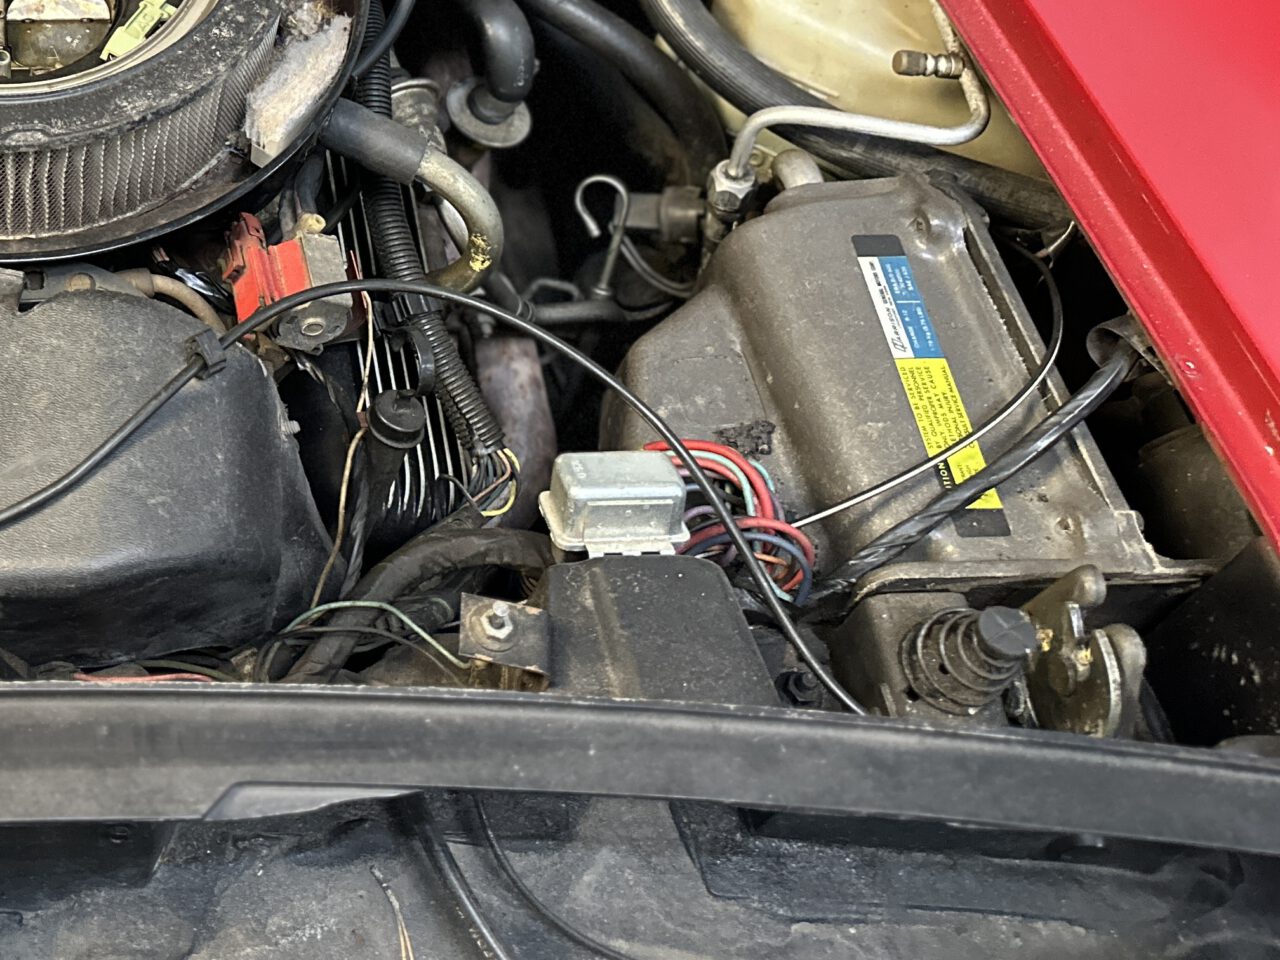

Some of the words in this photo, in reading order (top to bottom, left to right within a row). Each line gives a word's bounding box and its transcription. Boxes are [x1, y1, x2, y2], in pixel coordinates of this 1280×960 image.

[899, 366, 915, 398] SERVICED
[907, 367, 924, 400] PERSONNEL
[915, 366, 929, 392] SERVICE
[923, 366, 937, 388] CAUSE
[926, 396, 941, 425] IMPROPER
[933, 393, 944, 408] MAY
[950, 395, 964, 418] SERVICE
[916, 413, 924, 421] TO
[921, 404, 937, 436] QUALIFIED
[940, 412, 956, 441] ETHODS
[950, 416, 962, 437] SONAL
[921, 426, 933, 448] SYSTEM
[960, 420, 975, 447] CSULT
